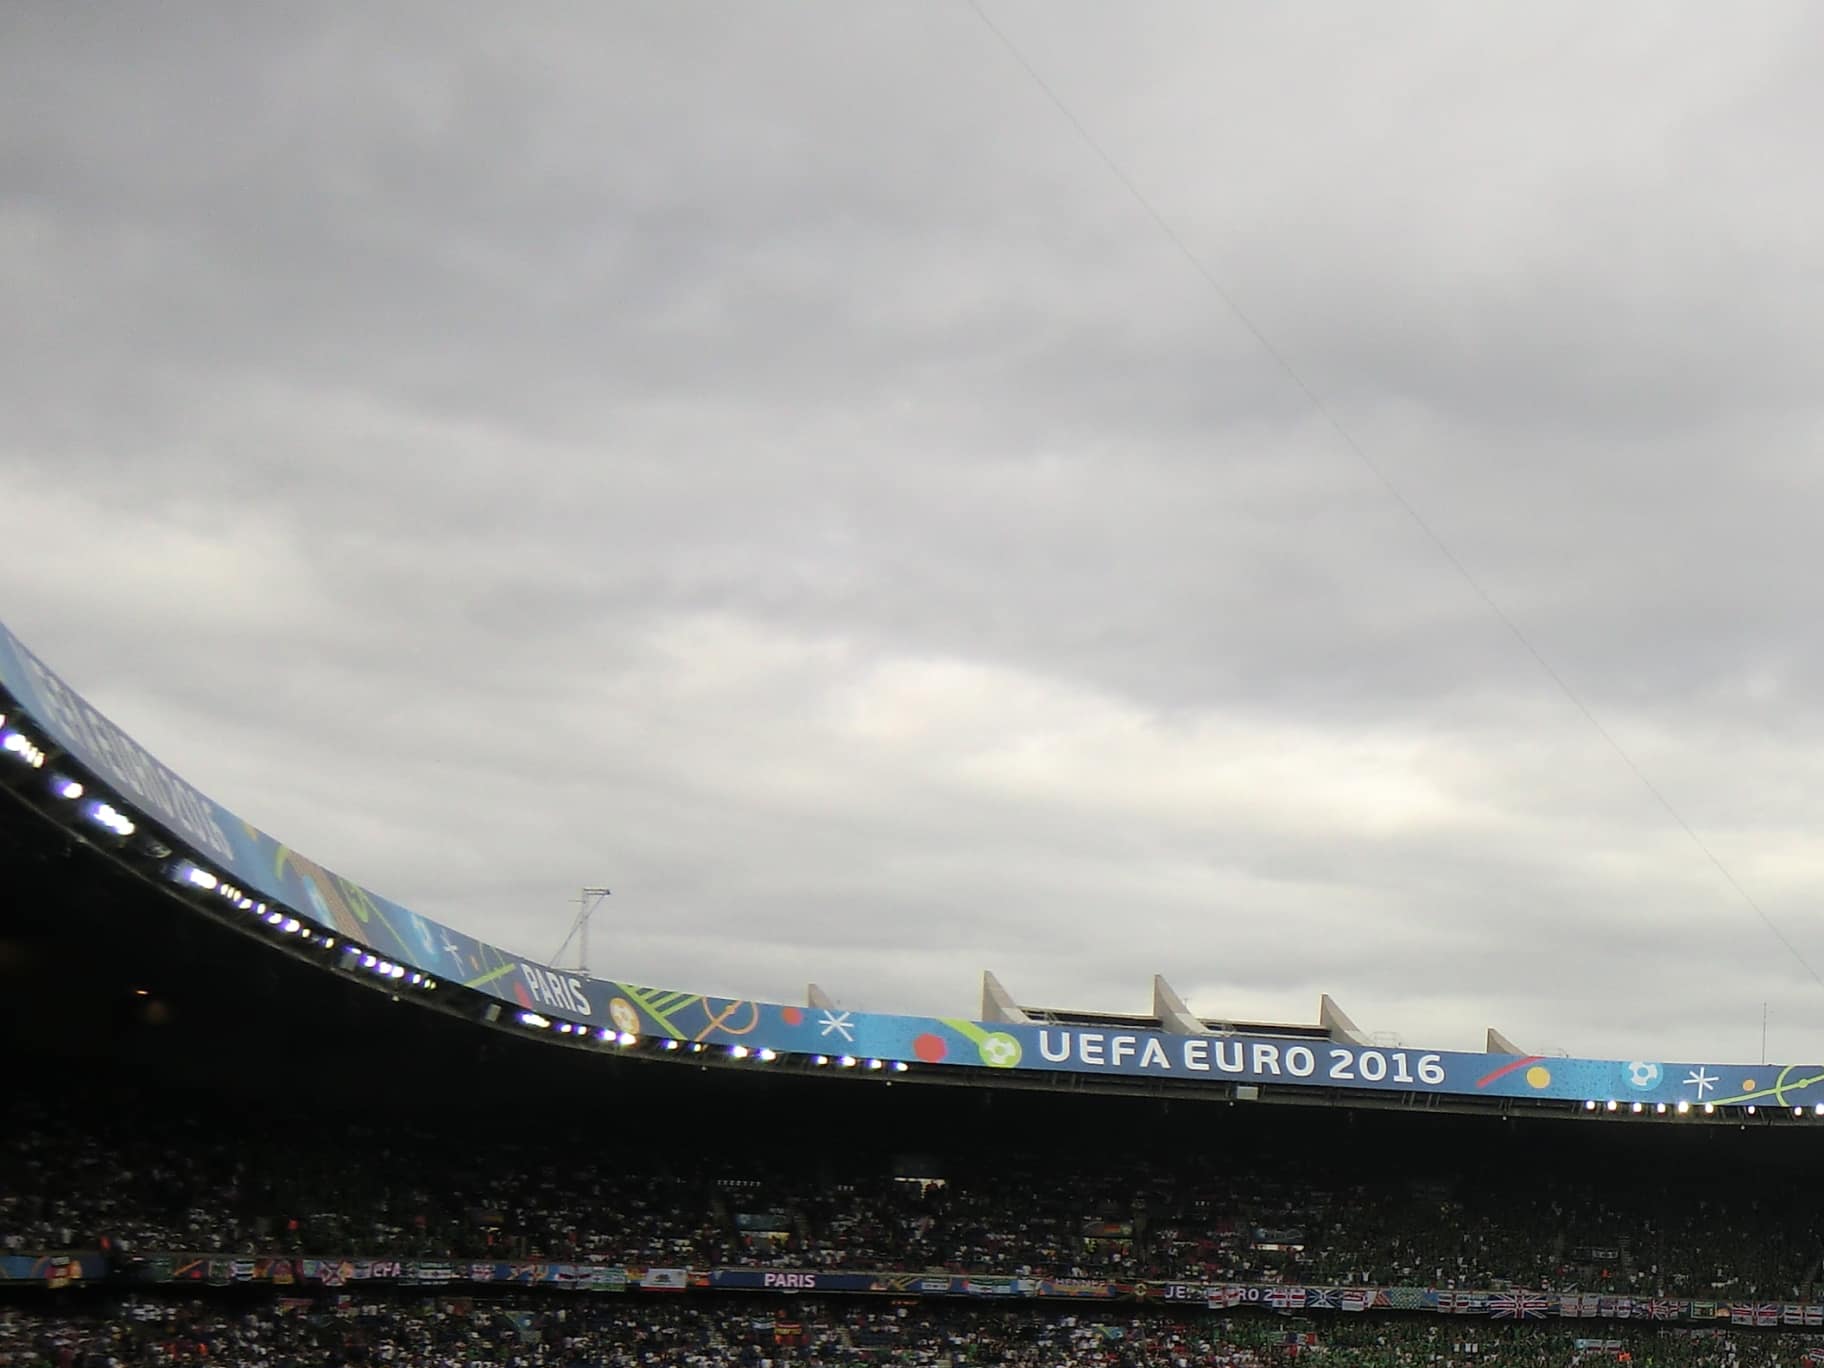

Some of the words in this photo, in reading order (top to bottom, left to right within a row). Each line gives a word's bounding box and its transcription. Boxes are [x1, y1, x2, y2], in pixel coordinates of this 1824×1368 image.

[520, 962, 592, 1015] PARIS
[1039, 1030, 1171, 1069] UEFA
[1183, 1039, 1316, 1077] EURO
[1328, 1049, 1446, 1084] 2016
[764, 1273, 816, 1289] PARIS
